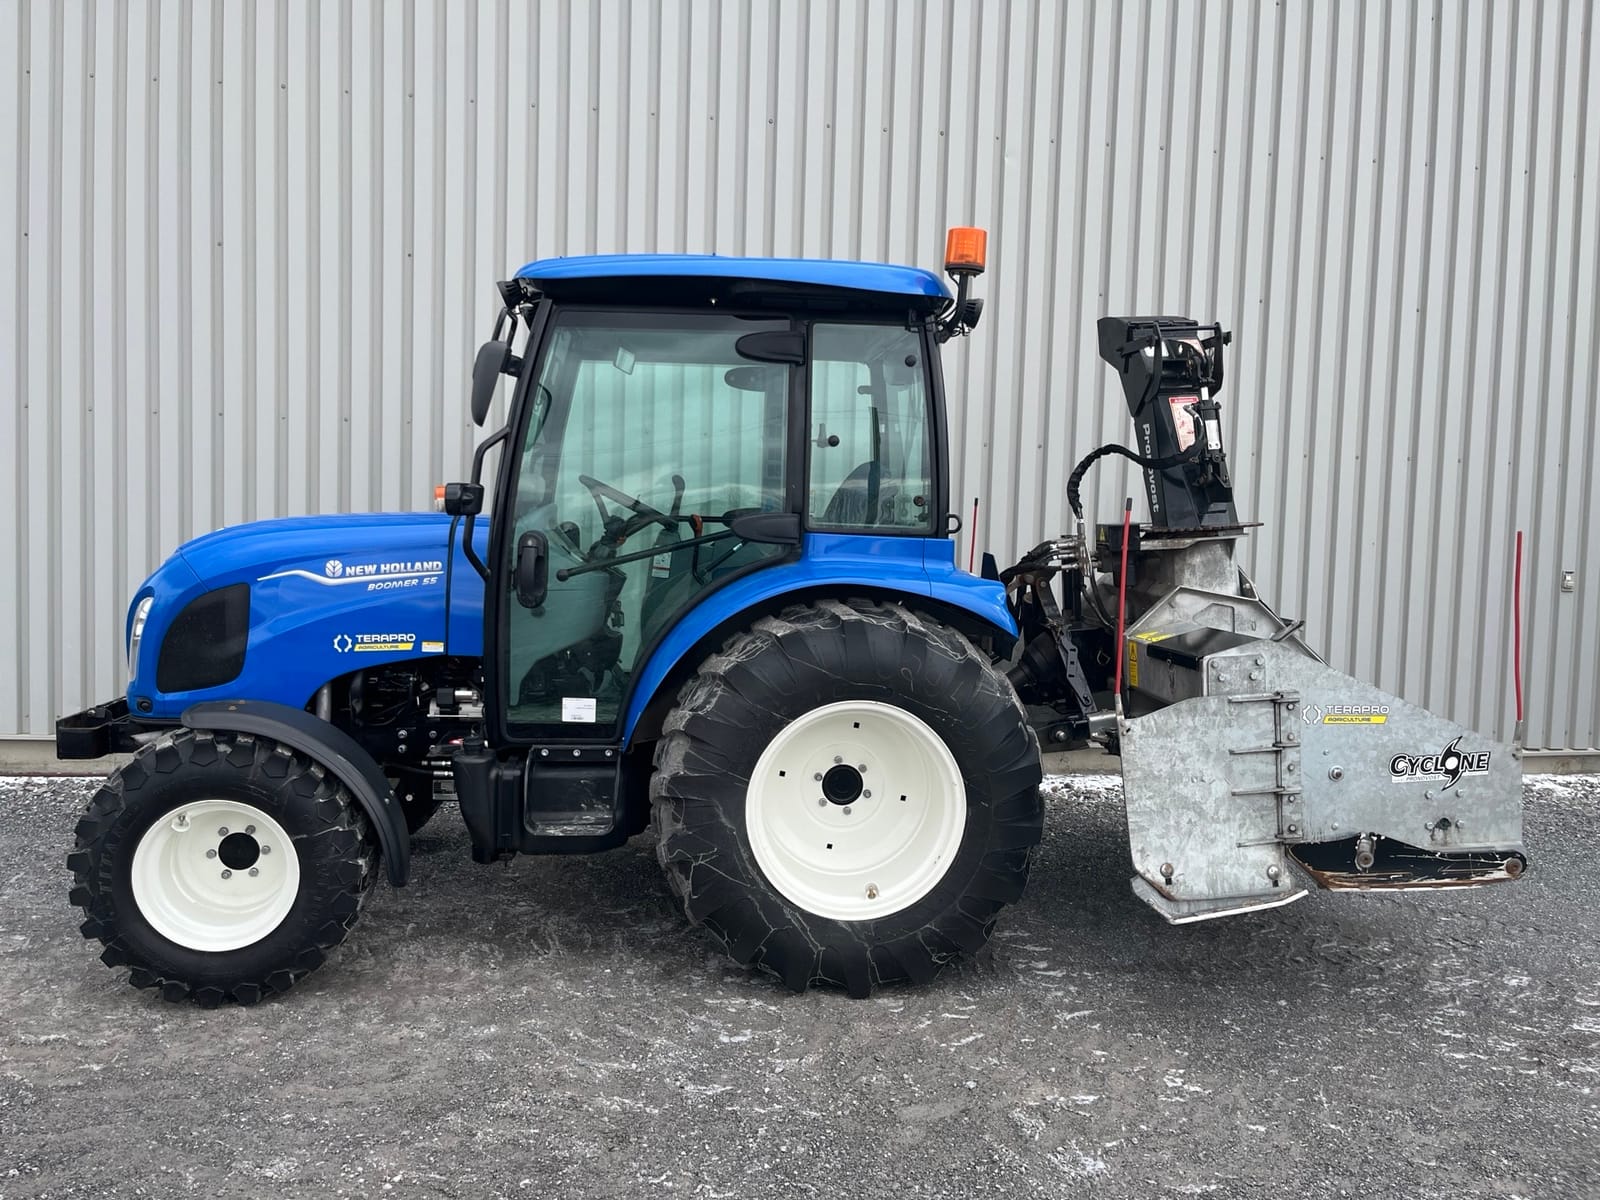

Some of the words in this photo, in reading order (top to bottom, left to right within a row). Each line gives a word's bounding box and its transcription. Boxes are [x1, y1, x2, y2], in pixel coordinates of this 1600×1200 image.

[345, 565, 378, 577] NEW
[380, 561, 443, 573] HOLLAND
[367, 579, 419, 591] BOOMER
[422, 577, 438, 586] 55
[355, 633, 416, 643] TERAPRO
[1326, 705, 1390, 715] TERAPRO
